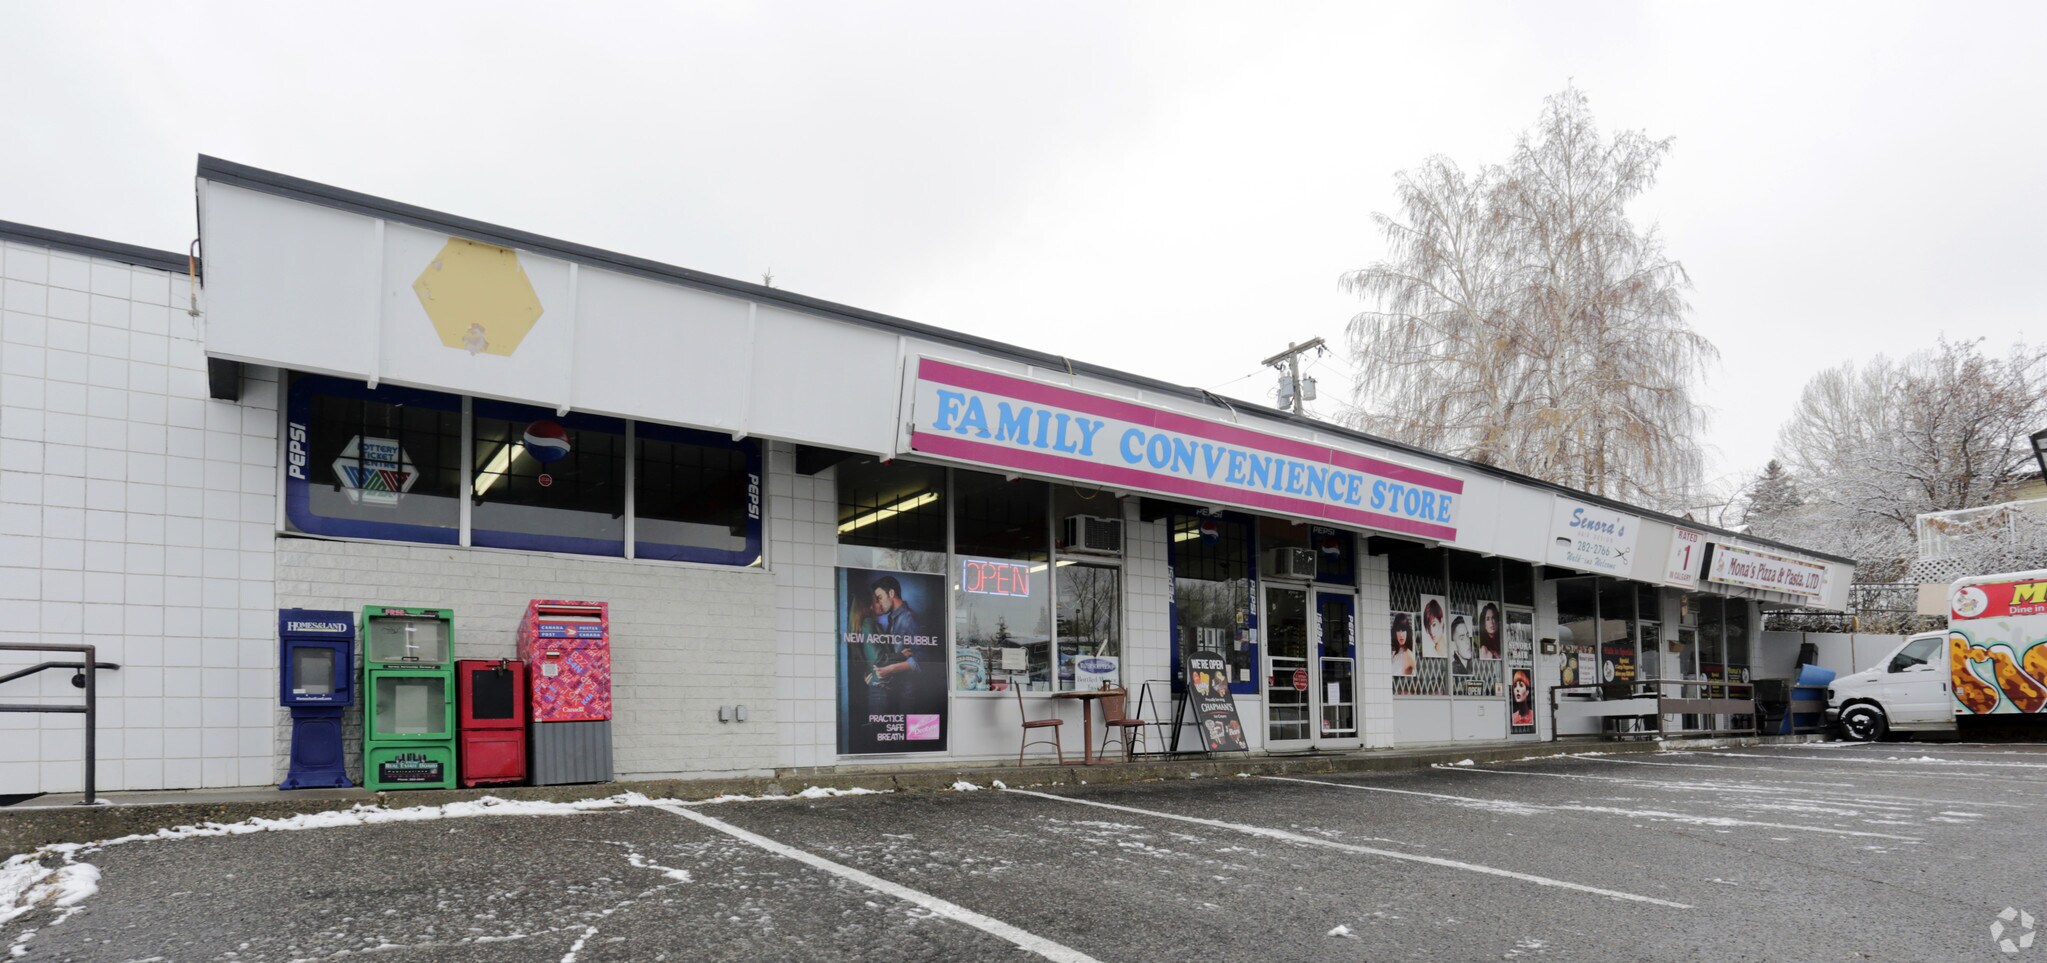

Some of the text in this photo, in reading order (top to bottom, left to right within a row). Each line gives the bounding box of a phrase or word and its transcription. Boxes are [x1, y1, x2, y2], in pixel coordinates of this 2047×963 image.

[289, 421, 306, 480] PEPSI
[357, 443, 398, 454] OTTERY
[932, 388, 1453, 524] FAMILY CONVENIENCE STORE
[748, 472, 760, 520] PEPSI
[1569, 507, 1625, 537] Senora's
[1312, 525, 1336, 537] PEPSI
[1678, 530, 1698, 543] RATED
[1577, 540, 1611, 556] 282-2766
[1683, 544, 1691, 571] 1
[967, 561, 1029, 596] OPEN
[1728, 557, 1756, 579] Mona's
[1756, 563, 1777, 582] Pizza
[1777, 567, 1785, 583] &
[1805, 572, 1820, 590] LTD
[1249, 579, 1257, 616] PEPSI
[2009, 604, 2045, 614] Dine in
[843, 631, 938, 646] NEW ARCTIC BUBBLE
[1190, 658, 1224, 669] WE'RE OPEN
[1467, 686, 1482, 696] OPEN
[1201, 703, 1234, 712] CHAPMAN'S
[869, 714, 904, 723] PRACTICE
[886, 723, 904, 732] SAFE
[877, 733, 904, 741] BREATH
